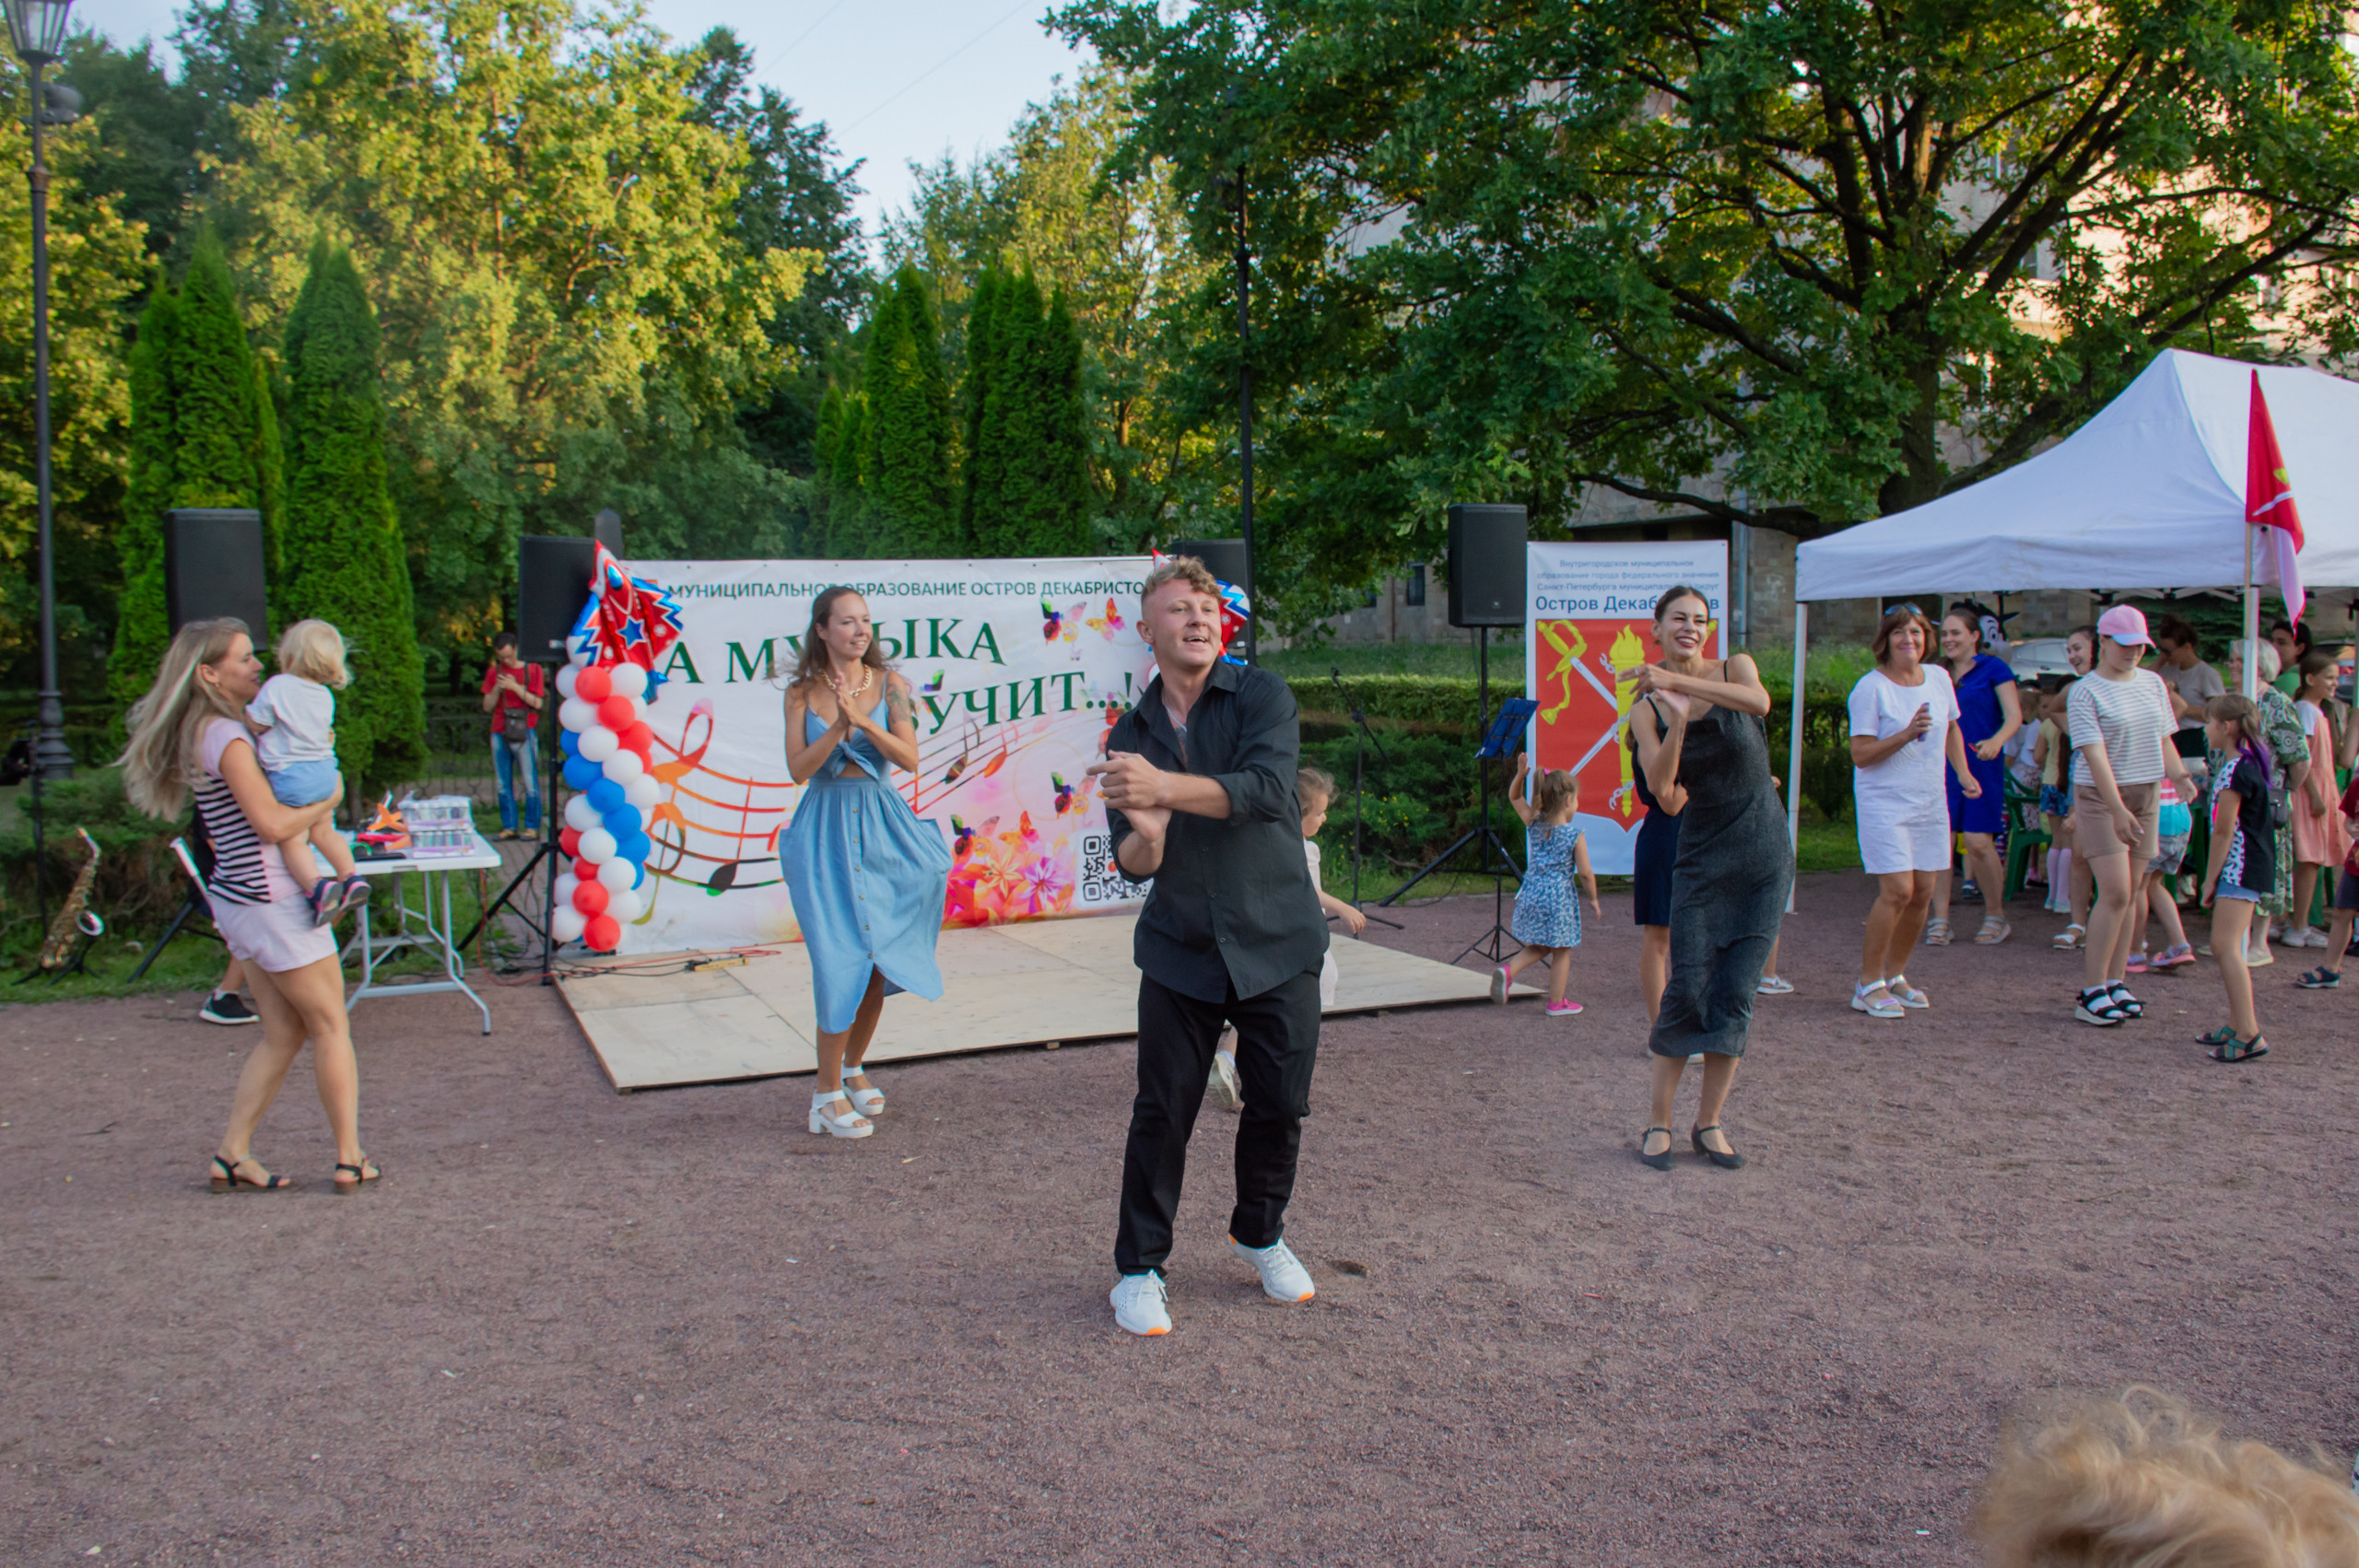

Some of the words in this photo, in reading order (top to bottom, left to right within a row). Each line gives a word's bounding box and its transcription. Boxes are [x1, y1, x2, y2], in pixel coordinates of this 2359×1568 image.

[1622, 571, 1679, 579] федерального
[970, 582, 1037, 596] ОСТРОВ
[1041, 581, 1144, 597] ДЕКАБРИСТО
[1537, 583, 1617, 591] Санкт-Петербурга
[1536, 595, 1599, 614] Остров
[1603, 595, 1719, 613] Декабв
[724, 618, 1008, 684] МЫКА
